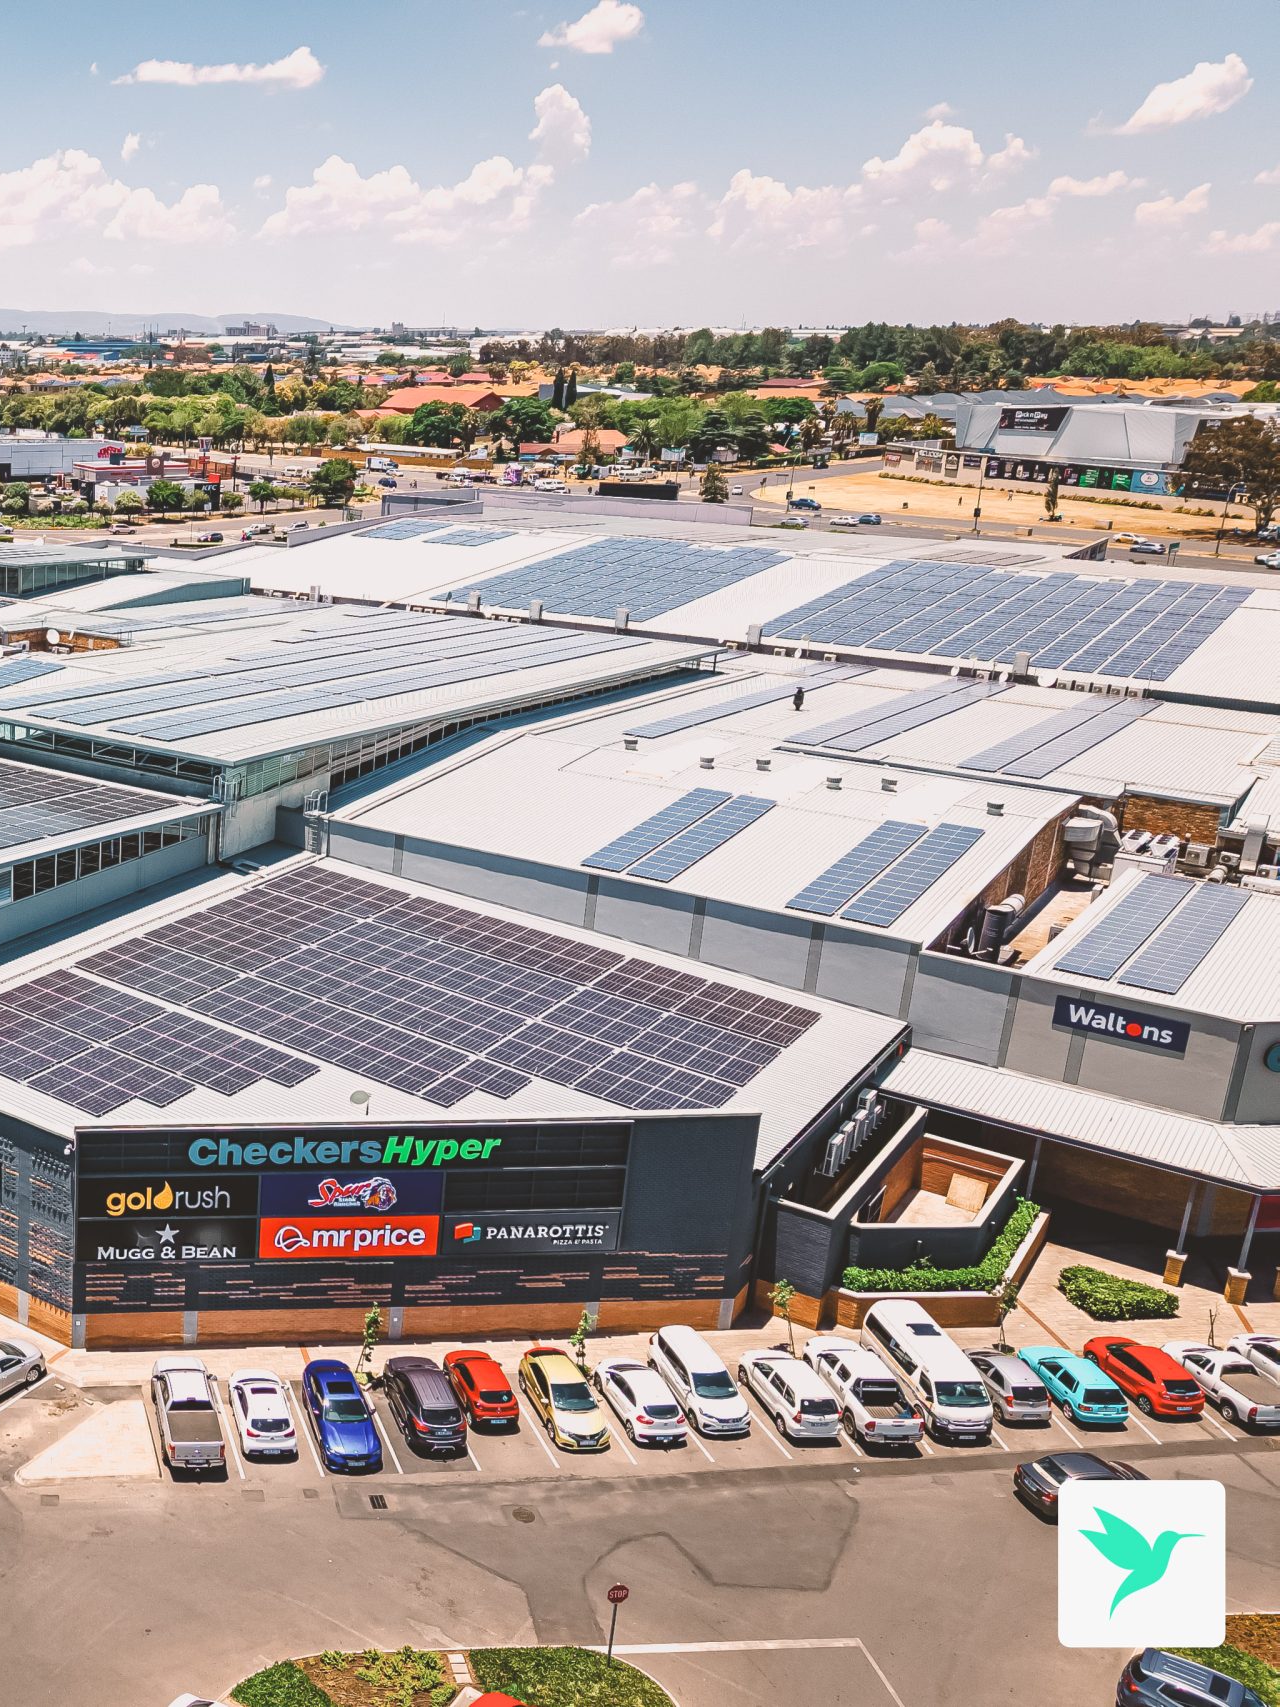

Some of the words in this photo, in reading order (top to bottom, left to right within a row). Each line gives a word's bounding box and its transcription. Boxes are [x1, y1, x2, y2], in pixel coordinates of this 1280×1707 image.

[1070, 1004, 1173, 1044] Waltons
[308, 1179, 372, 1207] Spur
[312, 1229, 351, 1247] mr
[354, 1225, 425, 1251] price
[486, 1225, 604, 1239] PANAROTTIS
[97, 1246, 155, 1260] MUGG
[161, 1246, 175, 1259] &
[182, 1245, 236, 1259] BEAN
[610, 1590, 628, 1598] STOP
